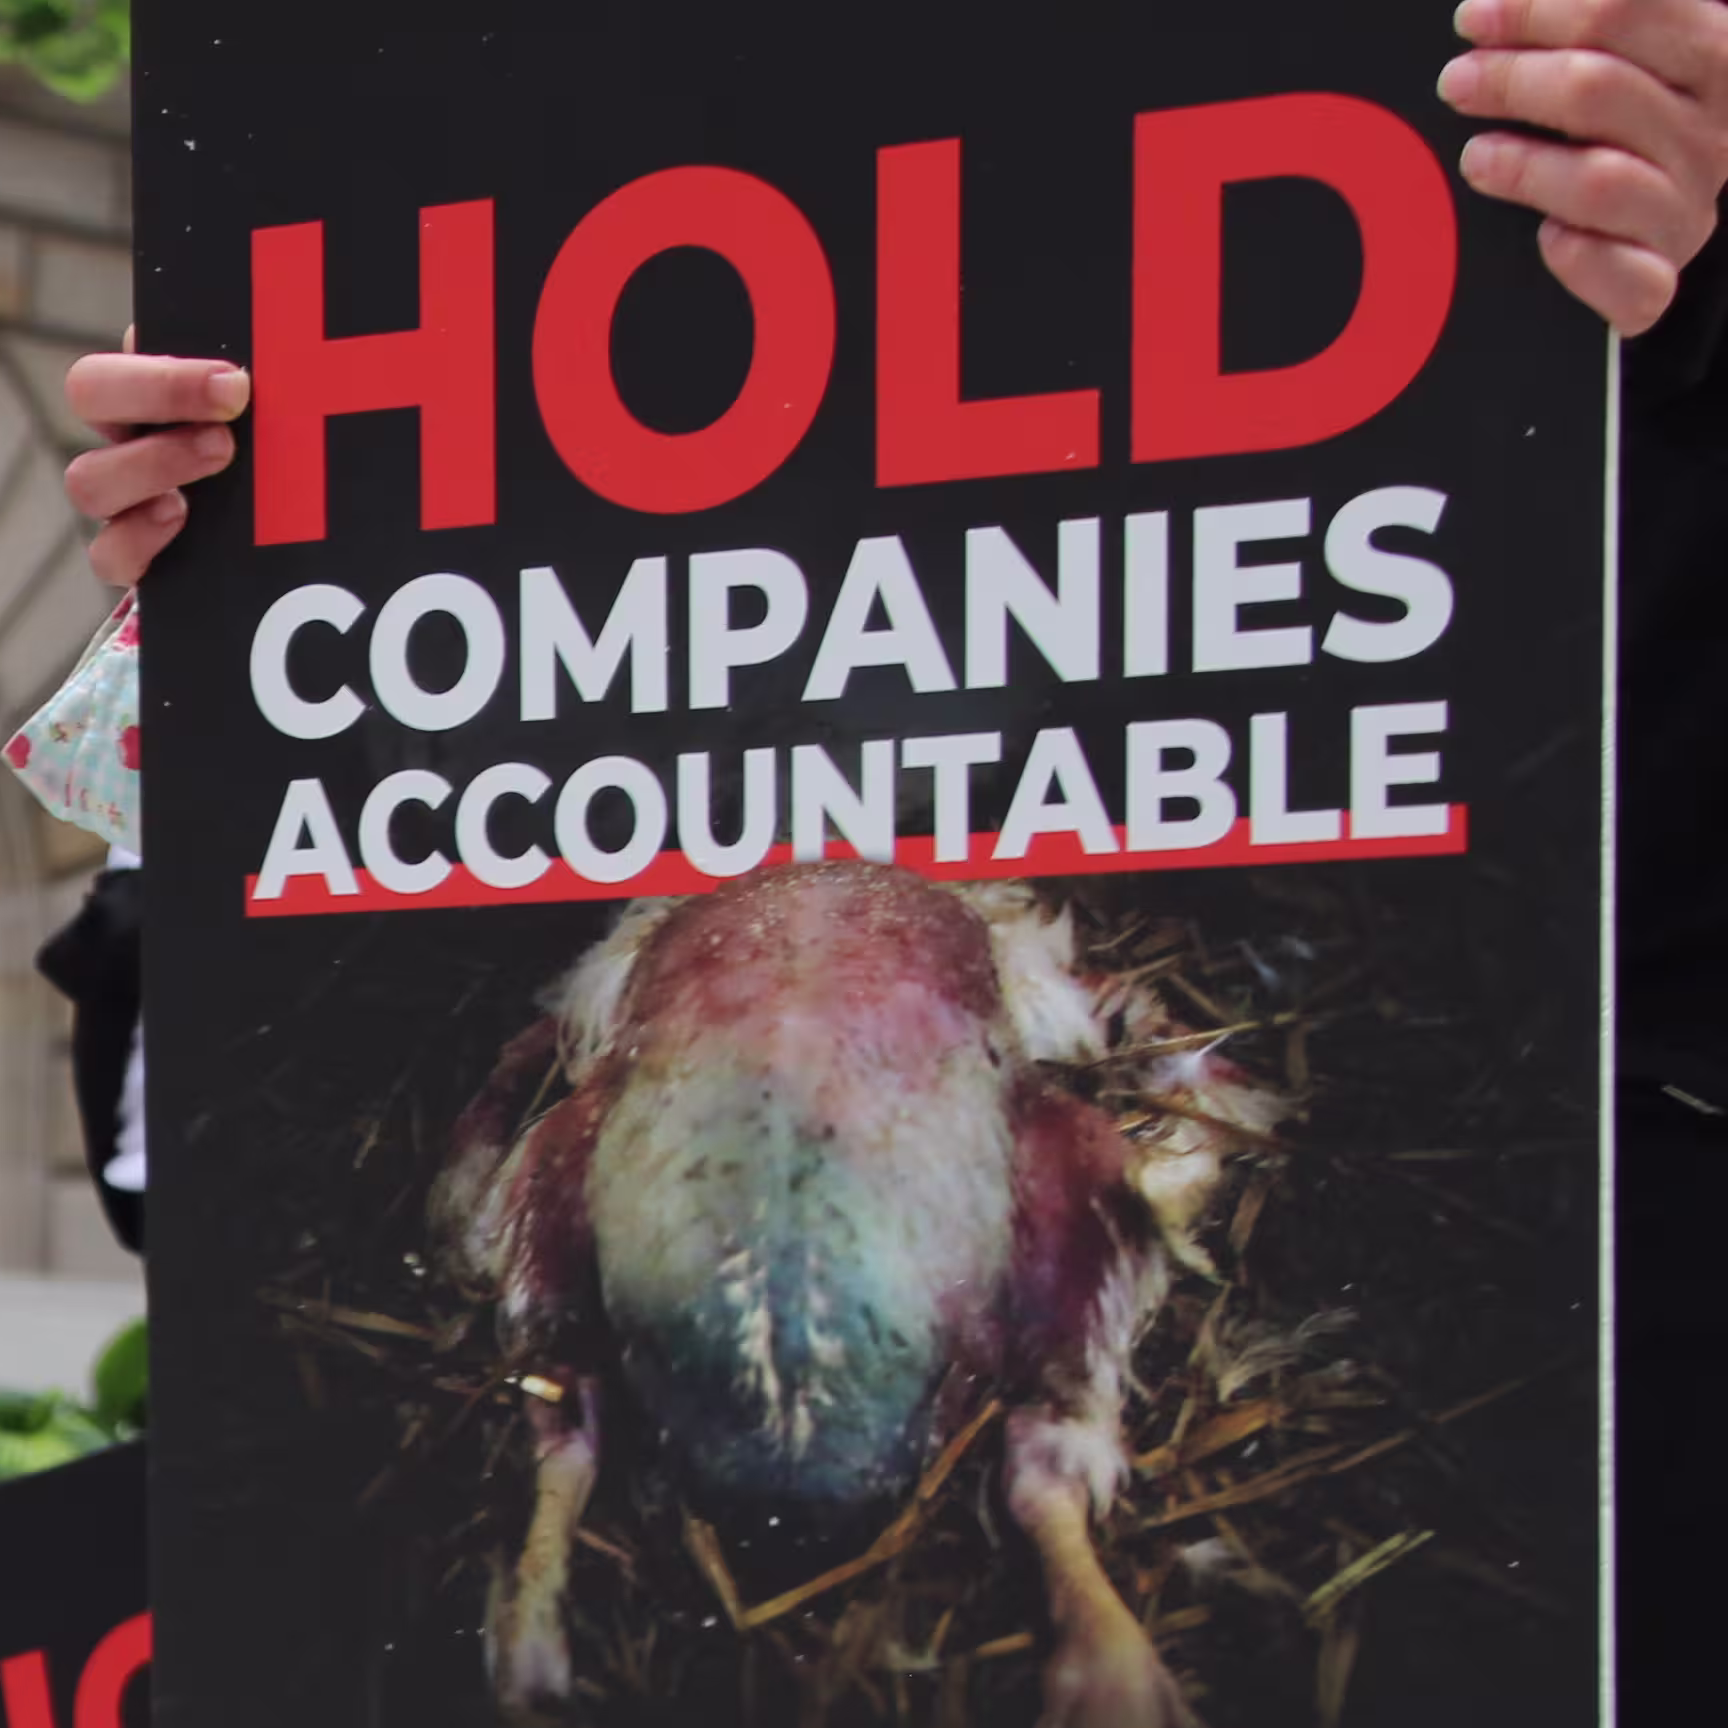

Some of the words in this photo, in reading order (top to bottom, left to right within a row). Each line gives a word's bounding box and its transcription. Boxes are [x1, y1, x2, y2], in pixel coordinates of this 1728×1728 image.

[251, 92, 1458, 546] HOLD
[250, 486, 1455, 739] COMPANIES
[252, 700, 1451, 899] ACCOUNTABLE
